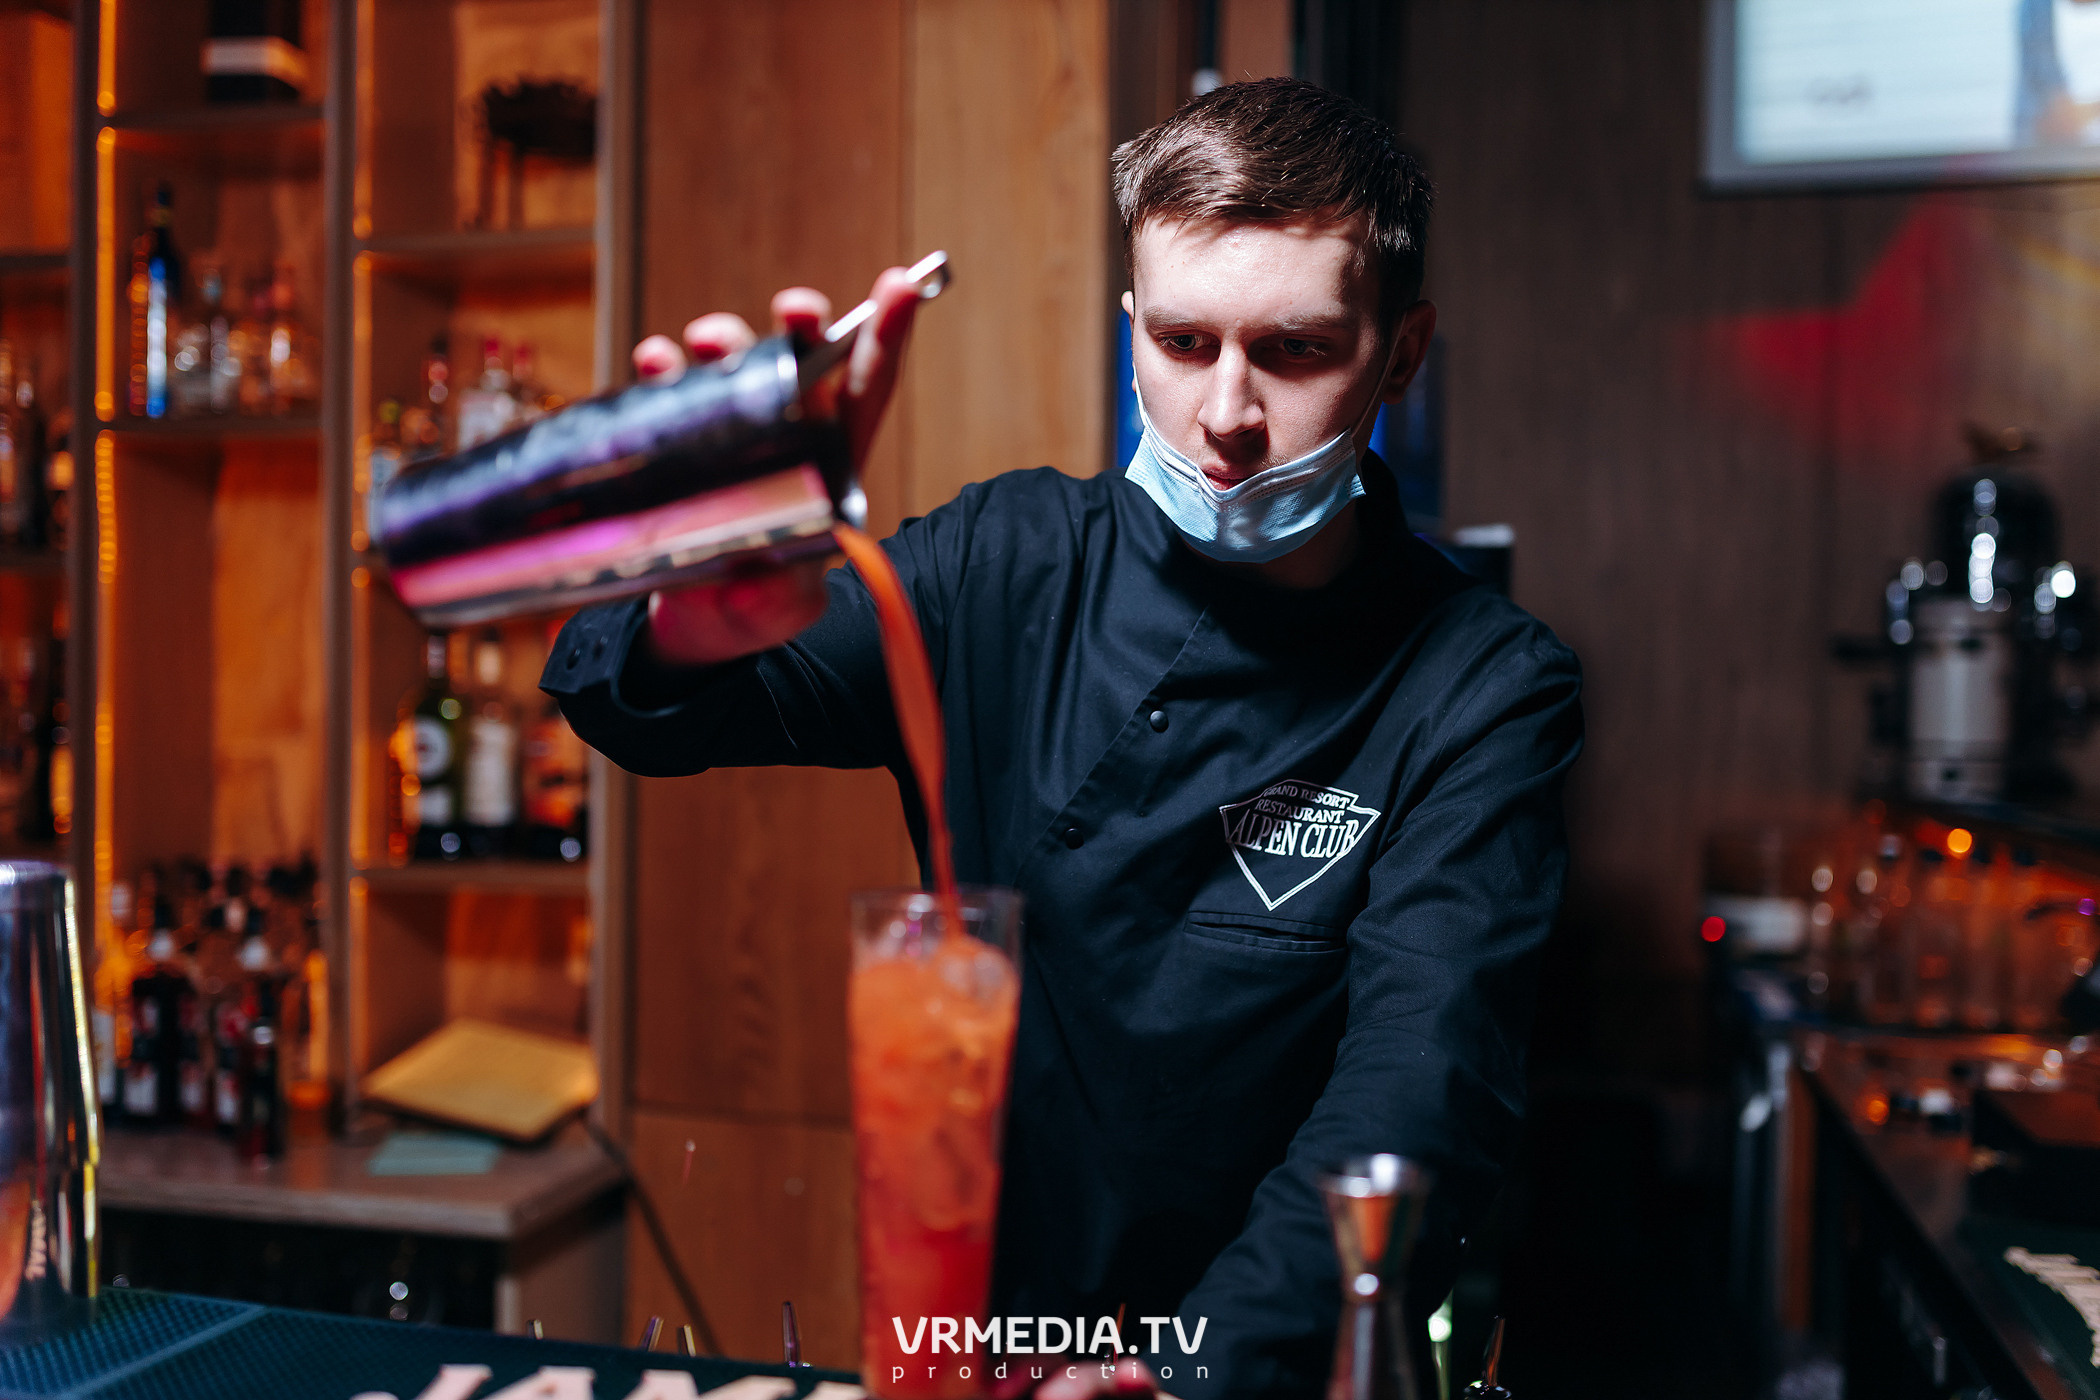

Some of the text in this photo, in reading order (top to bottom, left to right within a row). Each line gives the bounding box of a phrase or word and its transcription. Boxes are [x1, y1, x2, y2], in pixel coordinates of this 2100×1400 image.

[1263, 784, 1351, 810] GRAND RESORT
[1254, 798, 1345, 824] RESTAURANT
[1228, 808, 1360, 859] ALPEN CLUB
